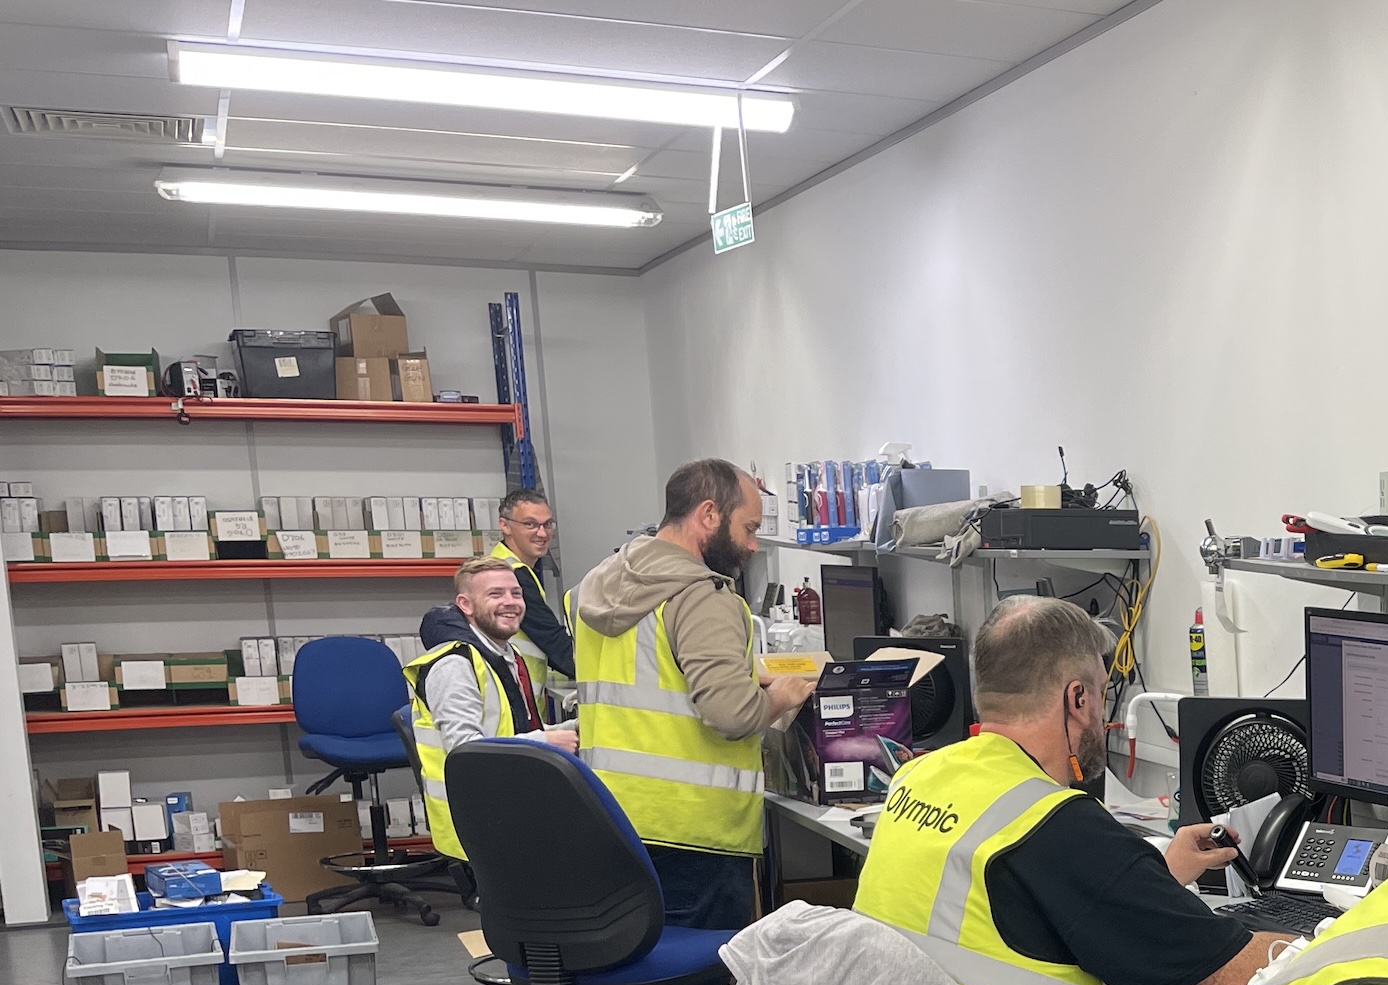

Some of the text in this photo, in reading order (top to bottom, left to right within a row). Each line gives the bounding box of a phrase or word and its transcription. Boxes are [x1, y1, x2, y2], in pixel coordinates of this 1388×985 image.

[736, 206, 751, 224] FIRE
[738, 225, 752, 241] EXIT
[887, 786, 959, 833] Olympic
